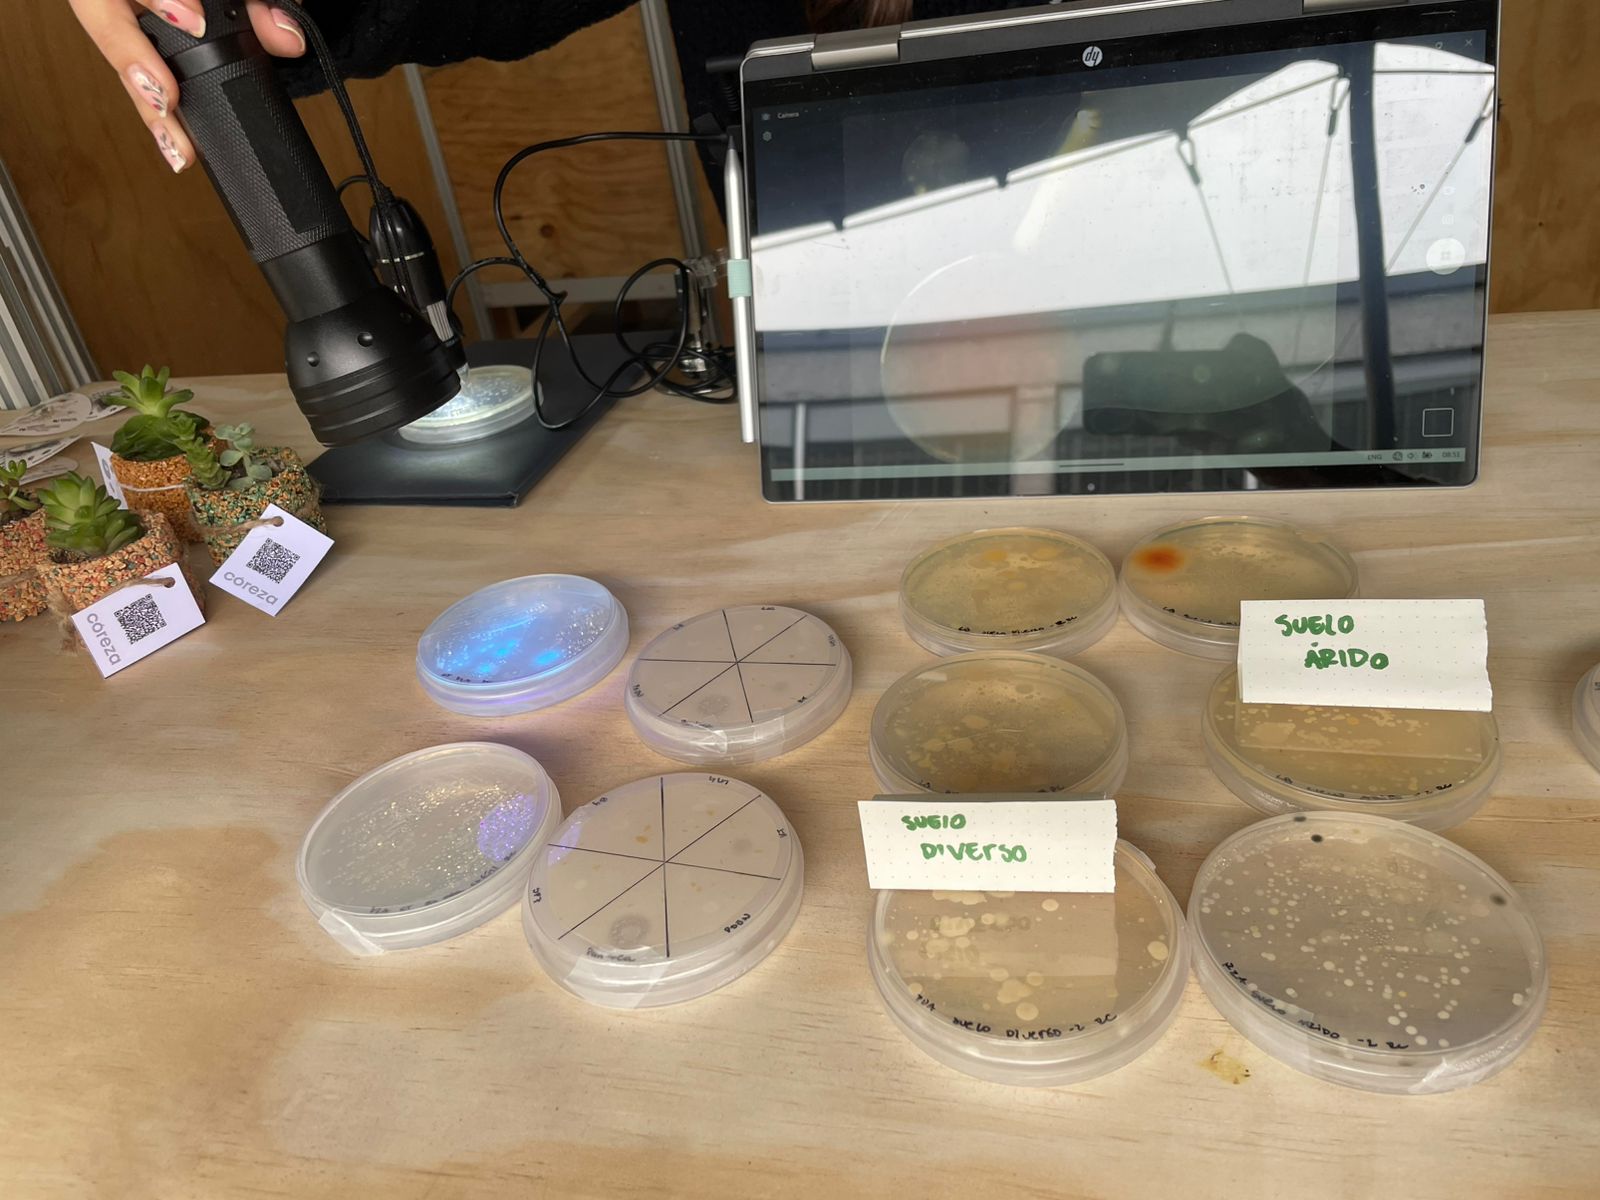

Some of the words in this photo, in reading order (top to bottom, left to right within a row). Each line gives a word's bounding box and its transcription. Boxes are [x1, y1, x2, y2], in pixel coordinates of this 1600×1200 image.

[777, 111, 800, 119] Camera
[223, 570, 279, 606] córeza
[86, 612, 122, 667] córeza
[1275, 614, 1355, 637] SUELO
[1304, 642, 1389, 670] ÁRIDO
